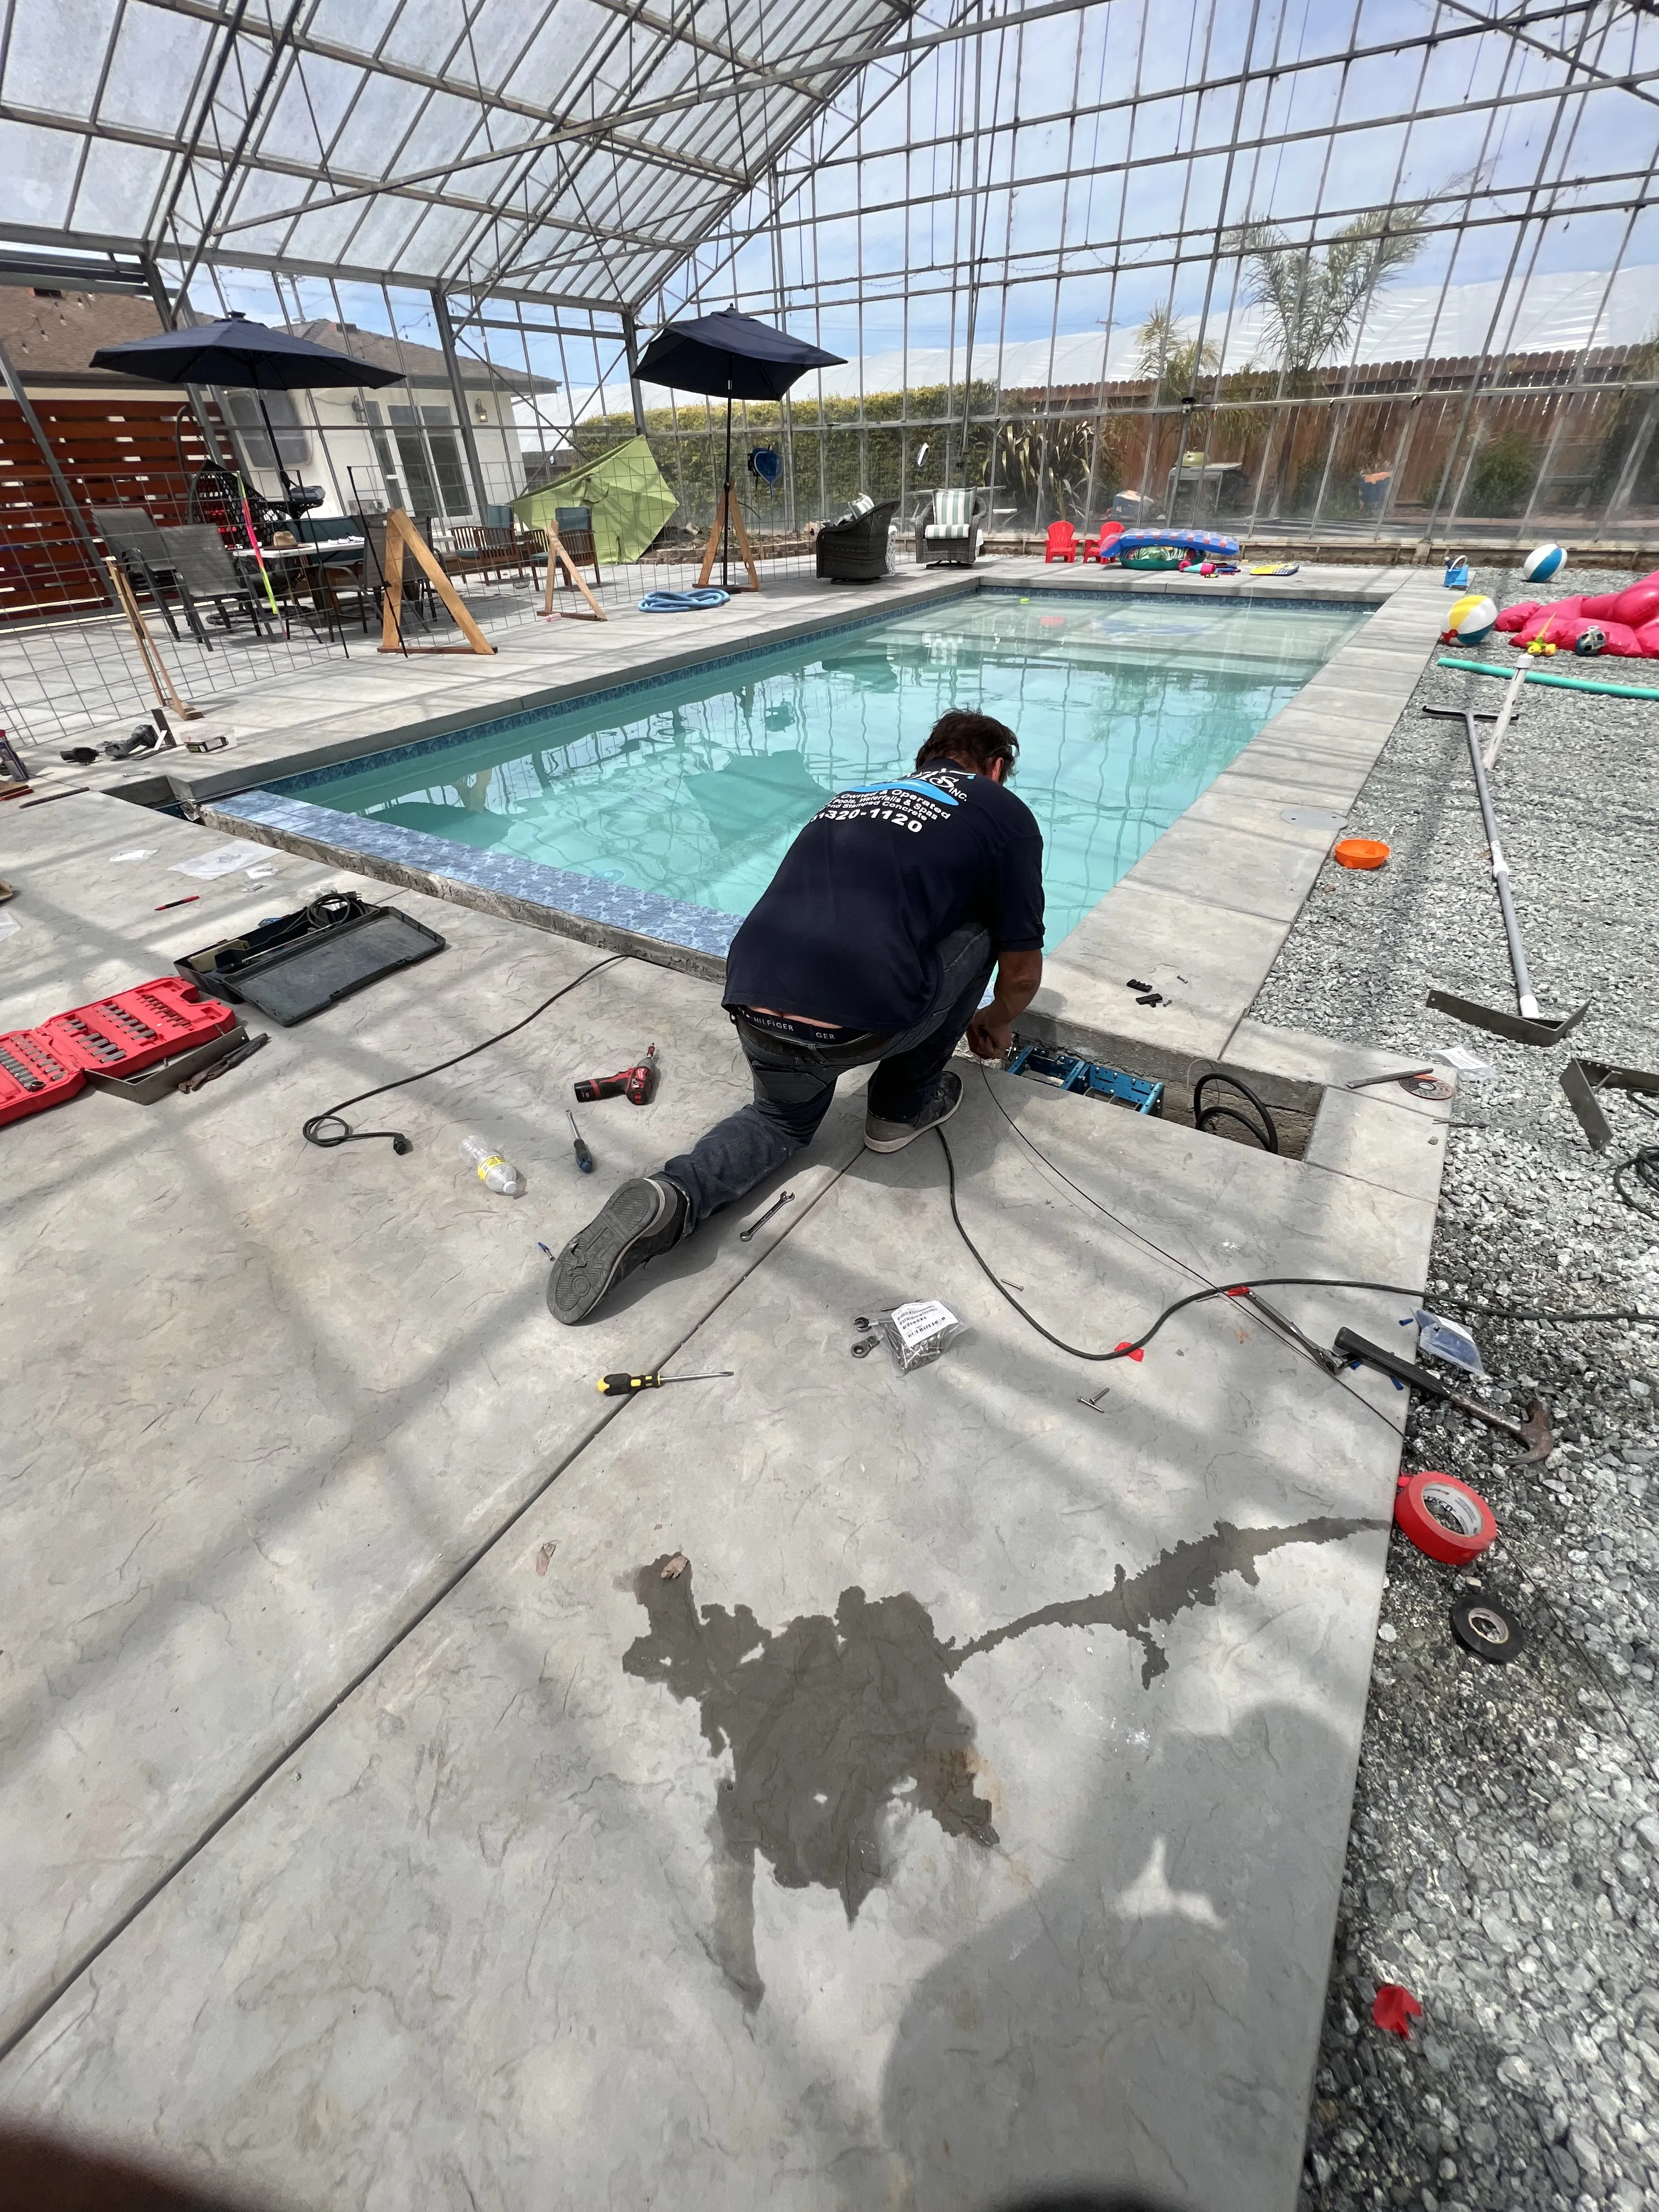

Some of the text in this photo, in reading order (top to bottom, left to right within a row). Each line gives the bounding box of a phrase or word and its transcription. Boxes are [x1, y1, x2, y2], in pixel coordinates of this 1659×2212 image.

[840, 791, 878, 799] Owned
[891, 789, 951, 820] Operated
[948, 787, 968, 802] INC.
[842, 800, 881, 809] Stamped
[882, 800, 927, 821] Concrete
[859, 795, 902, 803] Waterfalls
[903, 798, 911, 806] &
[913, 803, 938, 820] Spas
[753, 1016, 794, 1031] HILFIGER
